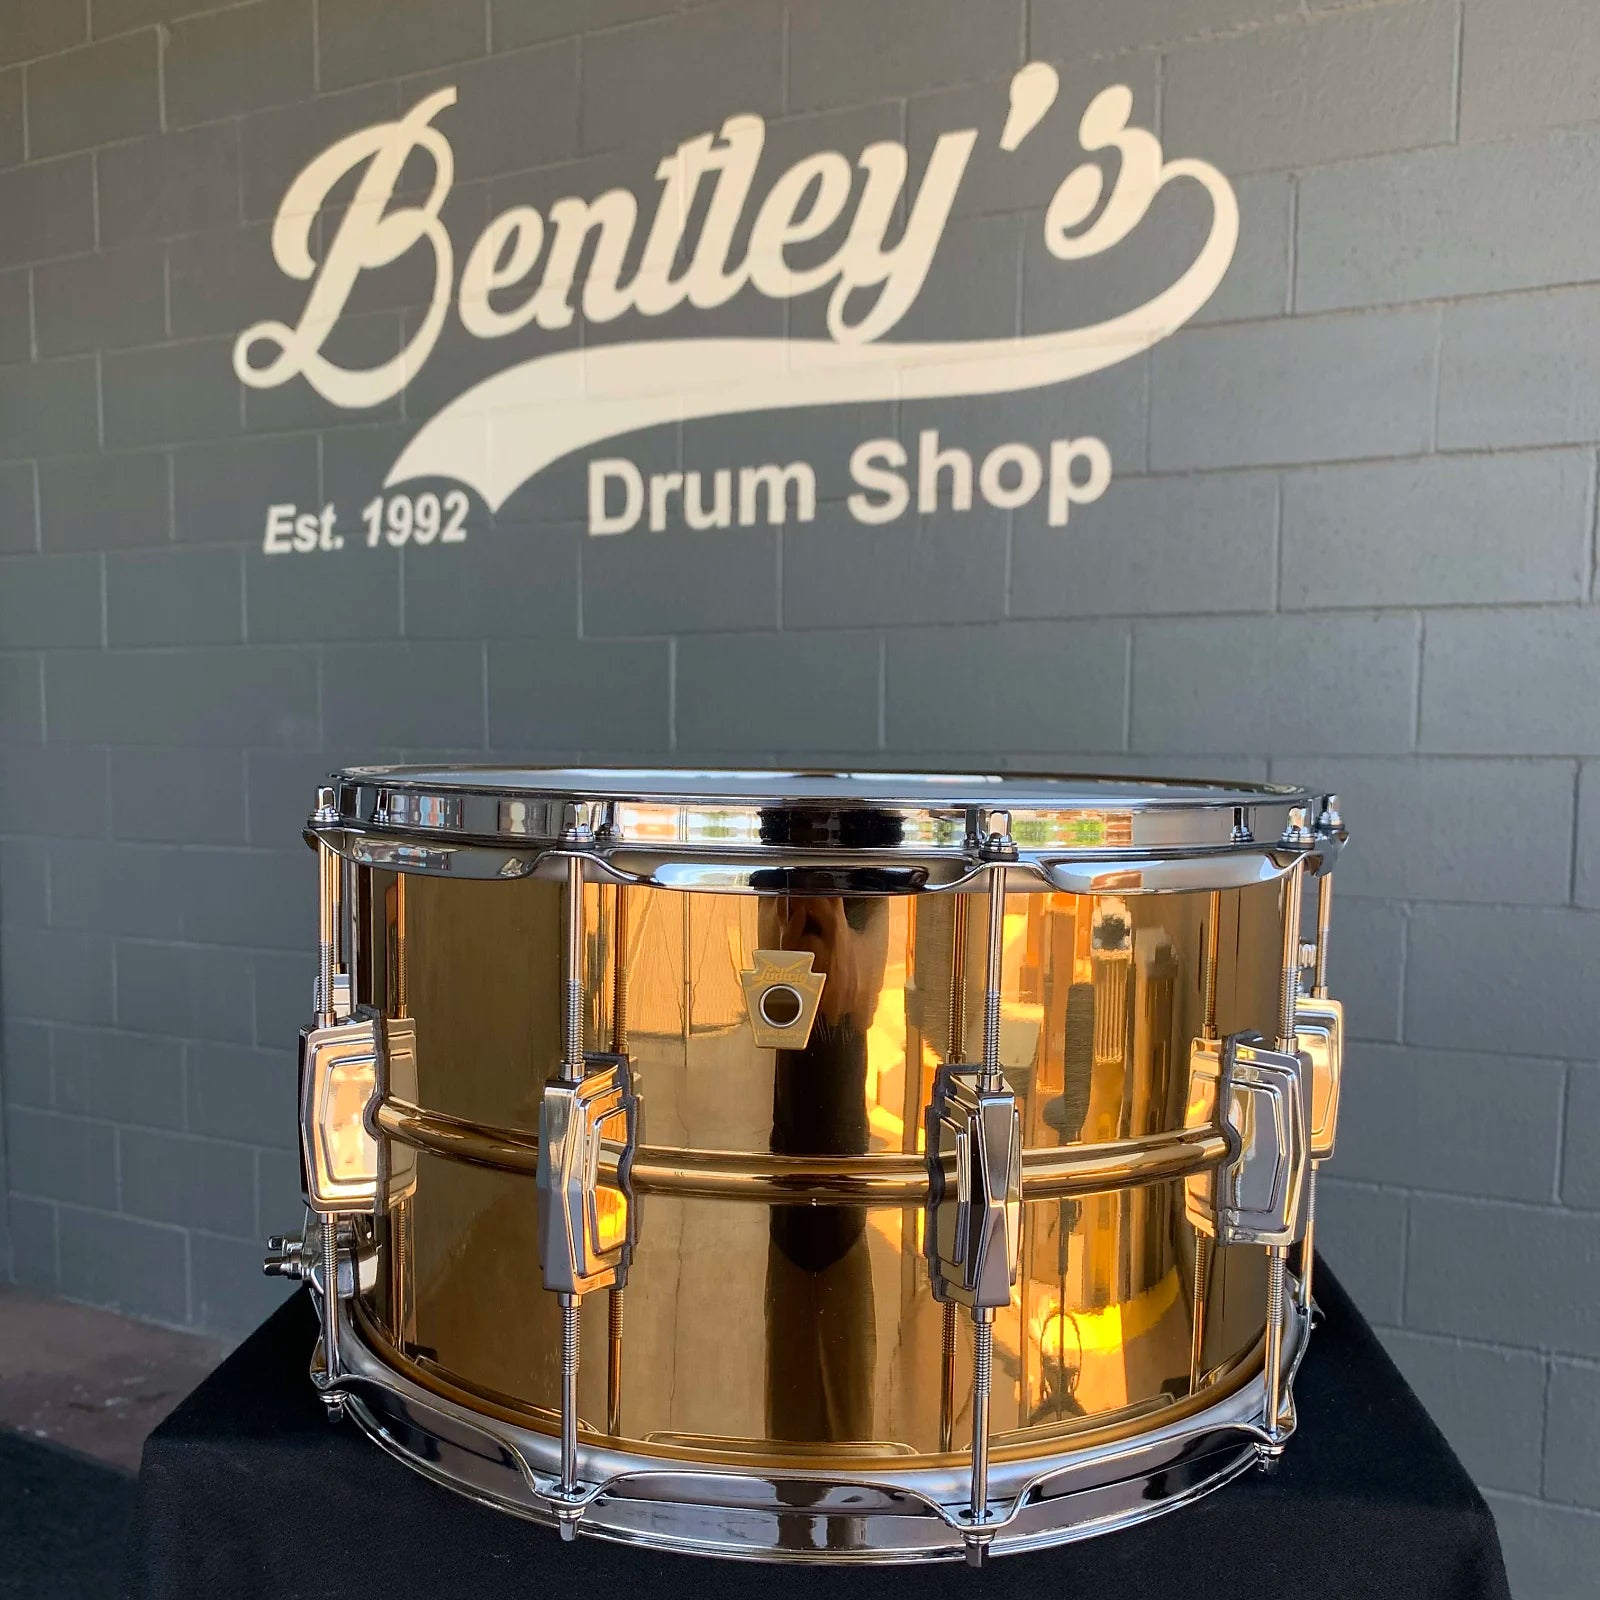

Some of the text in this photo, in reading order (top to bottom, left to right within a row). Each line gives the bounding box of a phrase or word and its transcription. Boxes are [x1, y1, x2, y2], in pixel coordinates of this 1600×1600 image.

[233, 62, 1240, 408] Bentley's
[263, 490, 470, 554] Est. 1992
[588, 429, 1112, 536] Drum Shop
